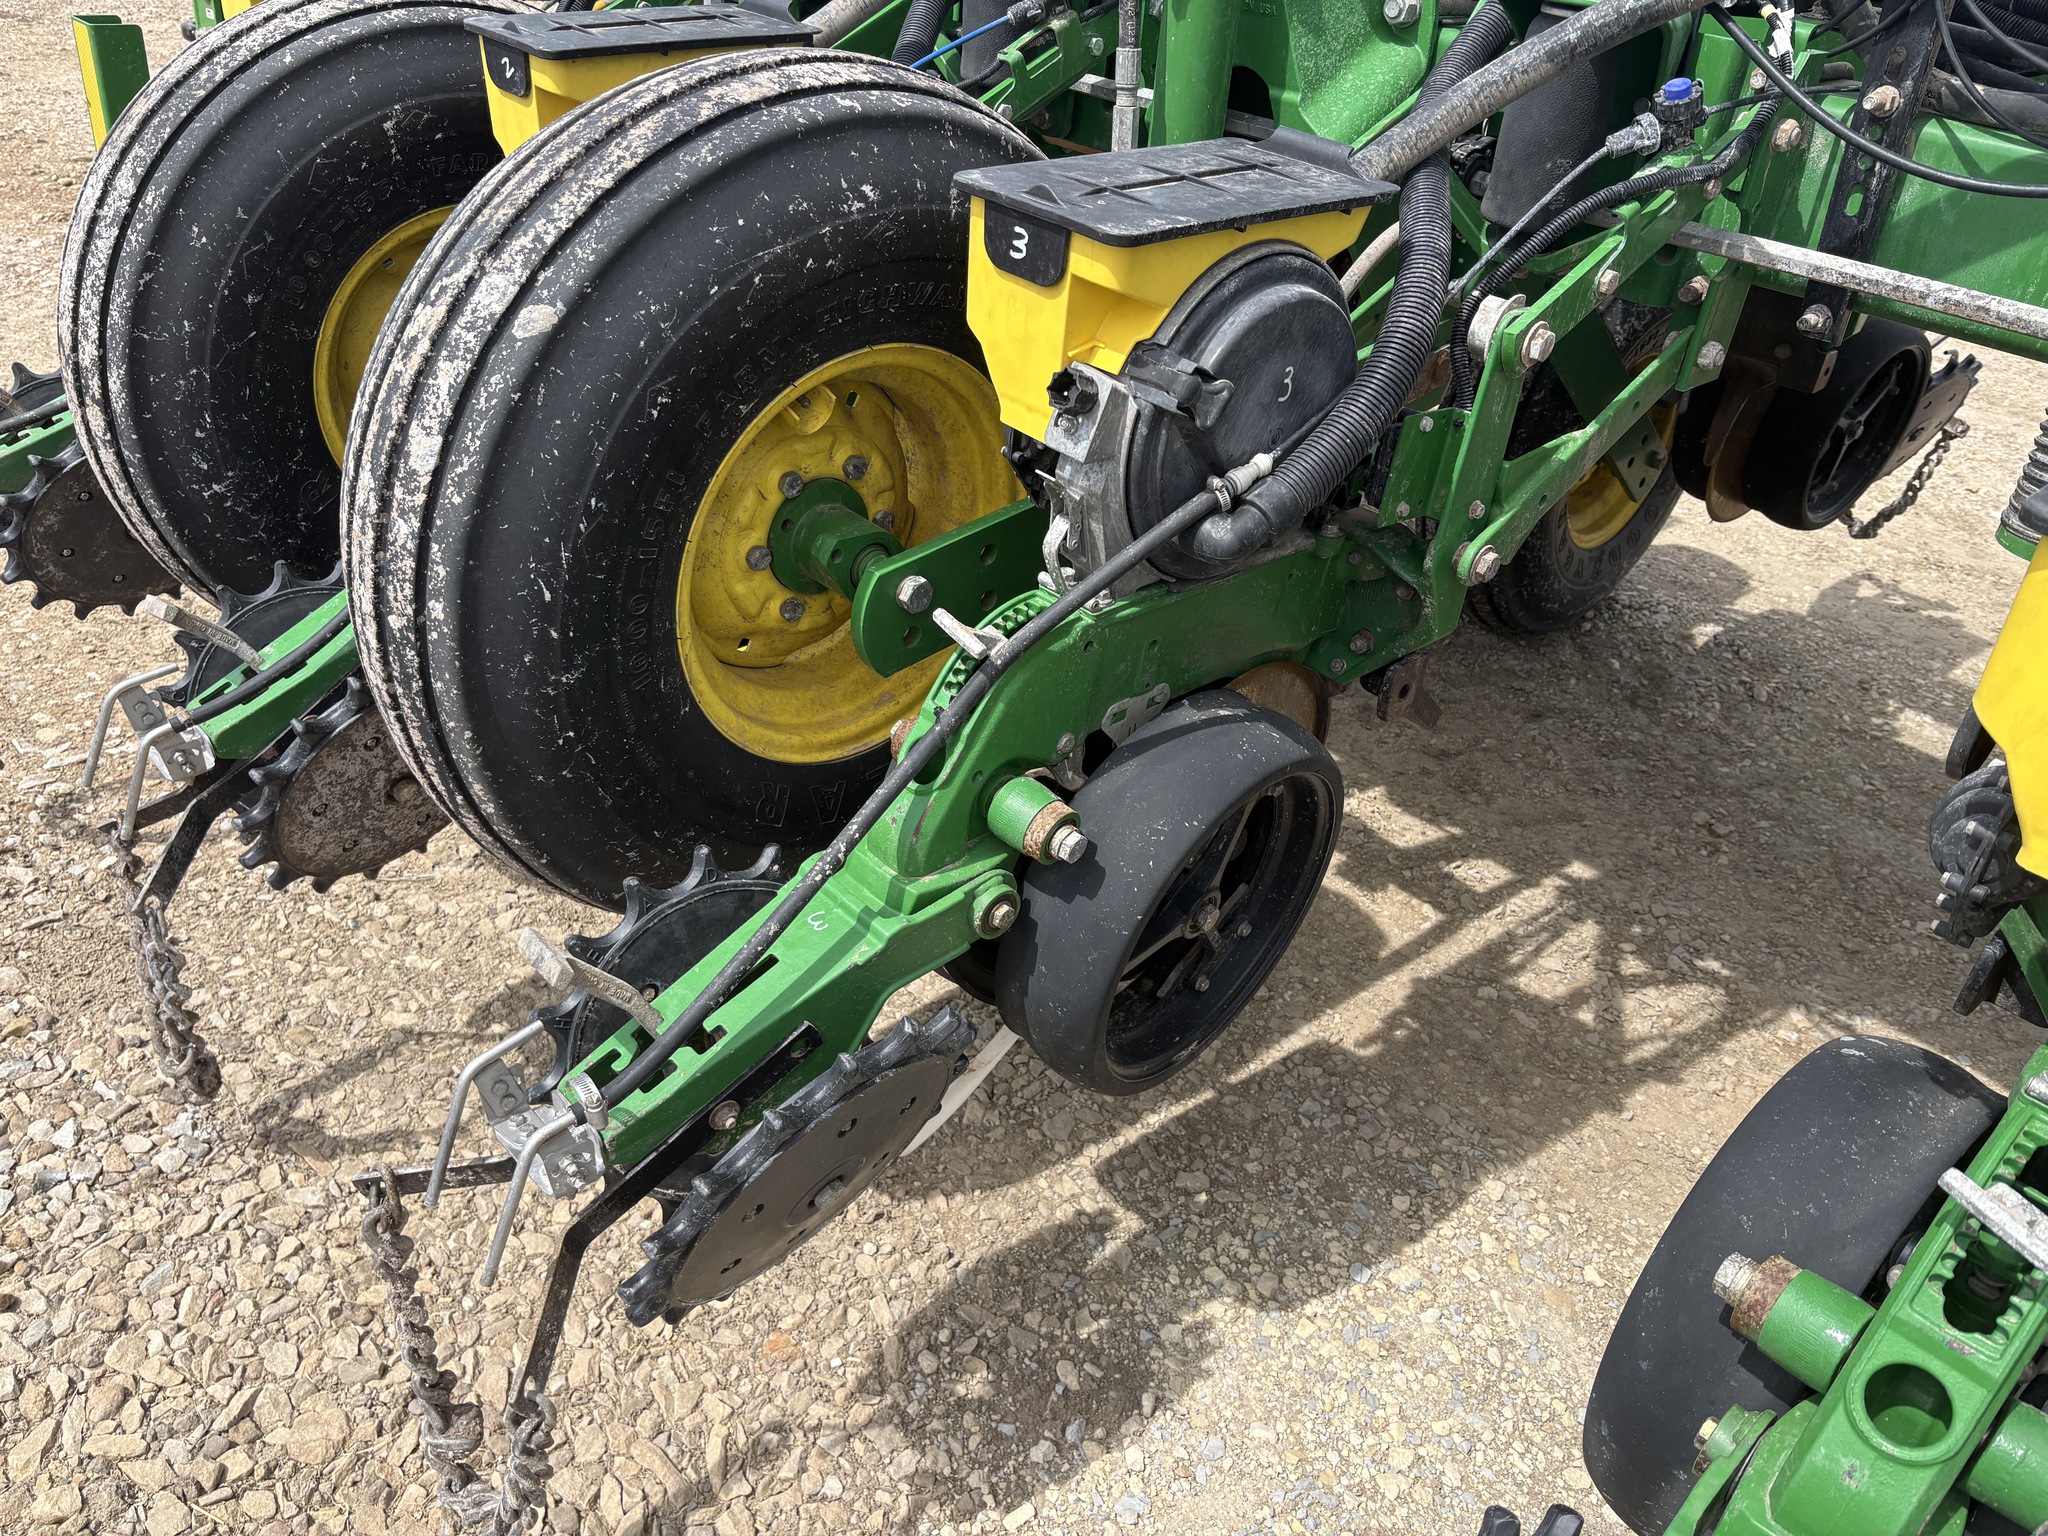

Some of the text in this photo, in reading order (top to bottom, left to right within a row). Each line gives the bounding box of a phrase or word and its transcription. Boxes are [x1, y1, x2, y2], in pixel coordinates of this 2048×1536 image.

[1259, 2, 1277, 17] USA
[500, 56, 517, 80] 2
[1009, 226, 1030, 260] 3
[1276, 365, 1295, 403] 3
[807, 909, 830, 932] 3
